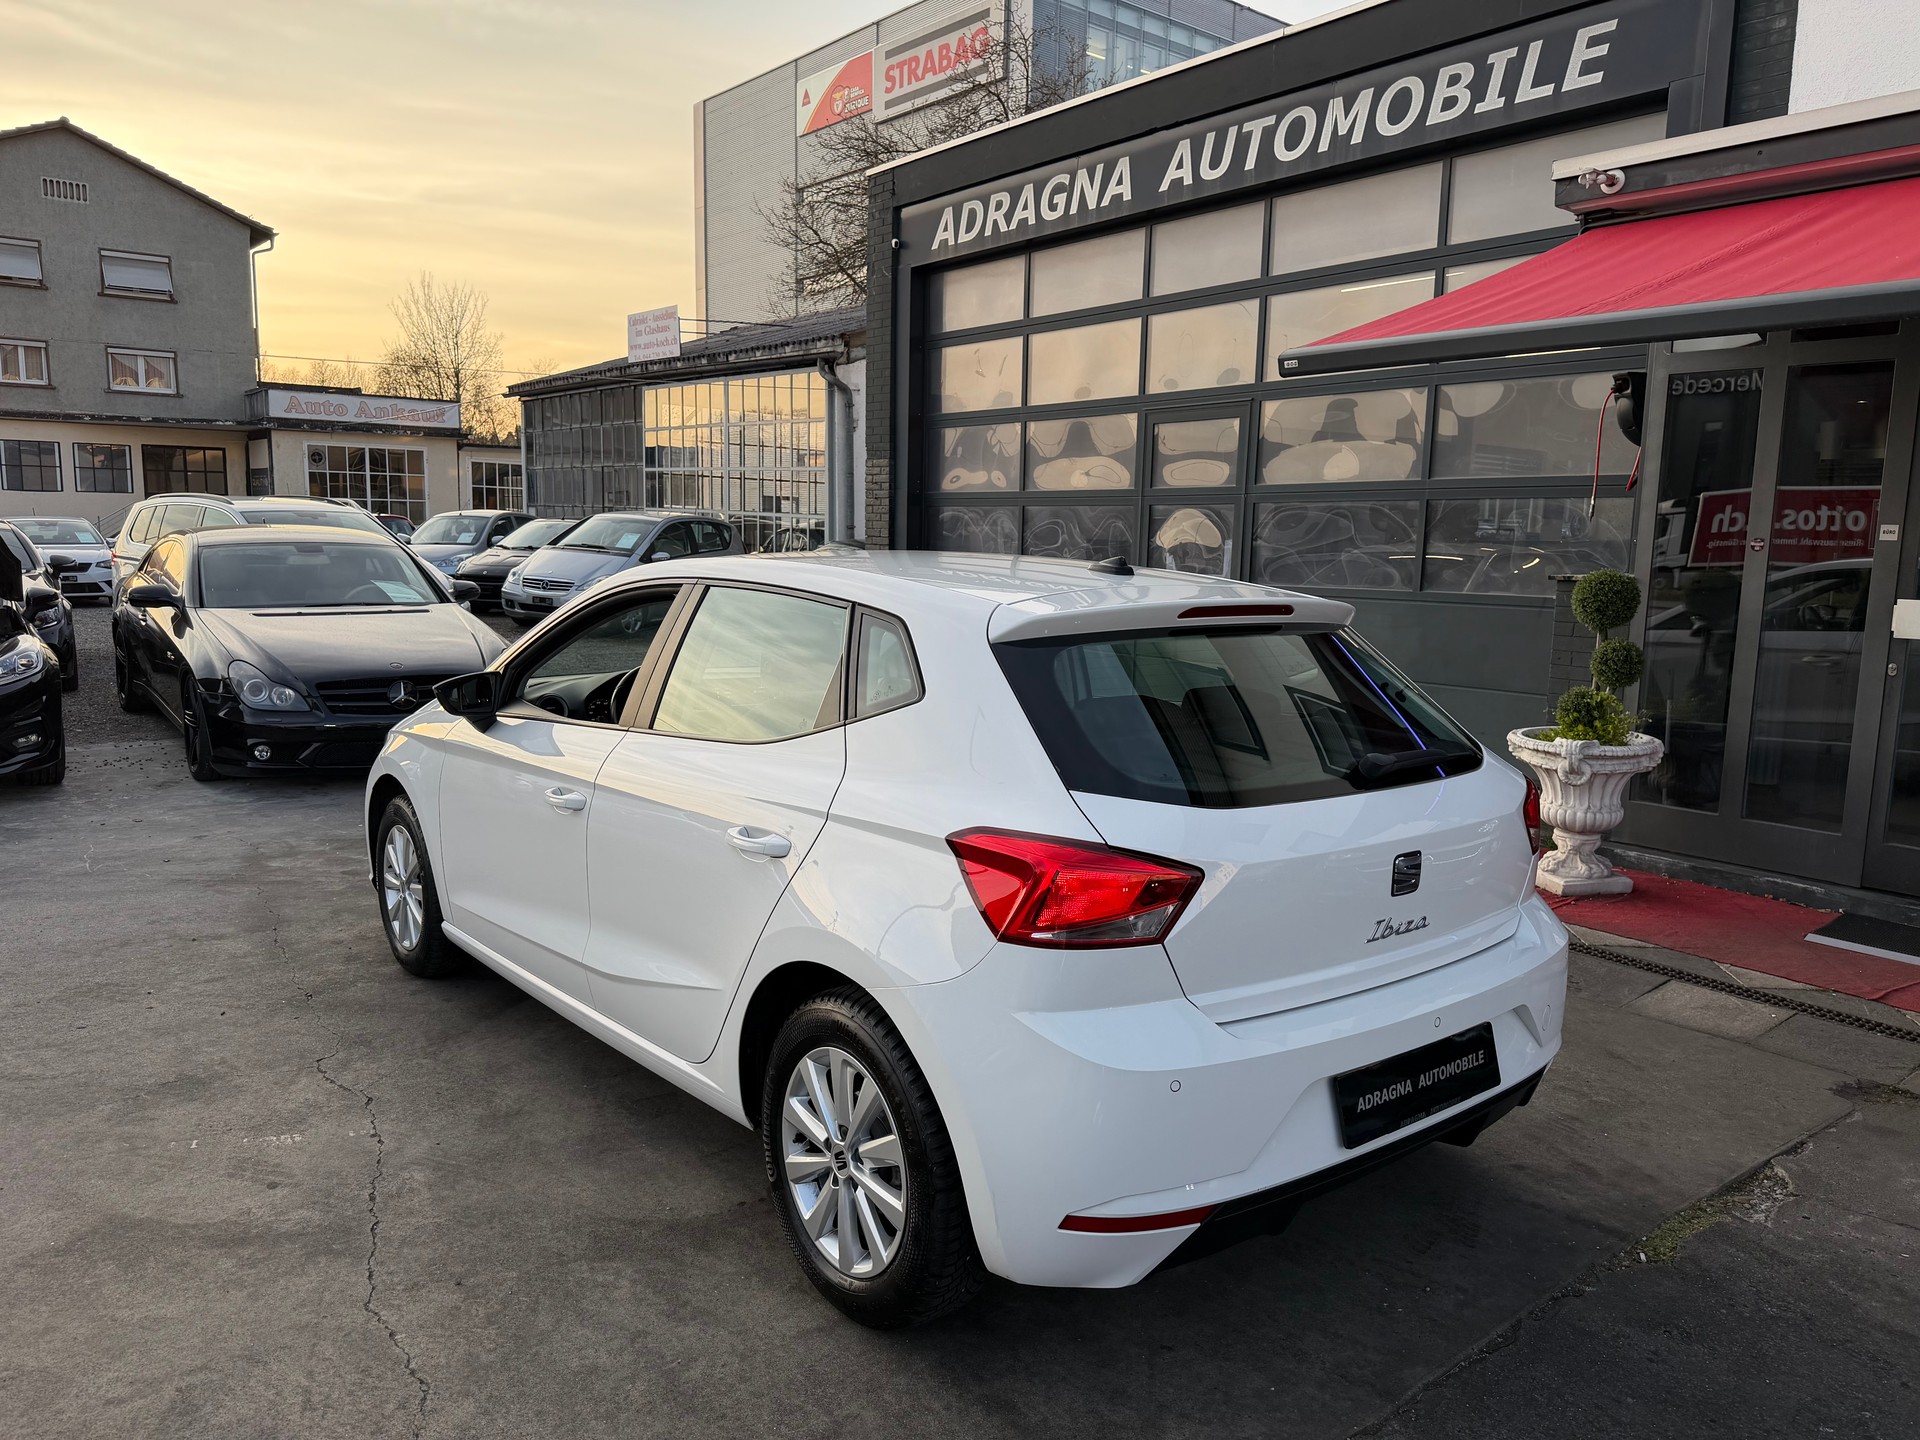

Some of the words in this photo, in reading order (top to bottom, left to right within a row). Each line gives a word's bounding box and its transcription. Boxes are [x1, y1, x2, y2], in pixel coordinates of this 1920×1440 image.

[884, 26, 991, 94] STRABAG
[931, 155, 1132, 251] ADRAGNA
[1158, 18, 1619, 192] AUTOMOBILE
[630, 335, 678, 350] www.auto-koch.ch
[644, 324, 671, 336] Glashaus
[284, 395, 348, 417] Auto
[354, 400, 446, 423] Ankauf
[1364, 915, 1430, 944] Ibiza
[1356, 1079, 1413, 1113] ADRAGNA
[1418, 1049, 1485, 1089] AUTOMOBILE
